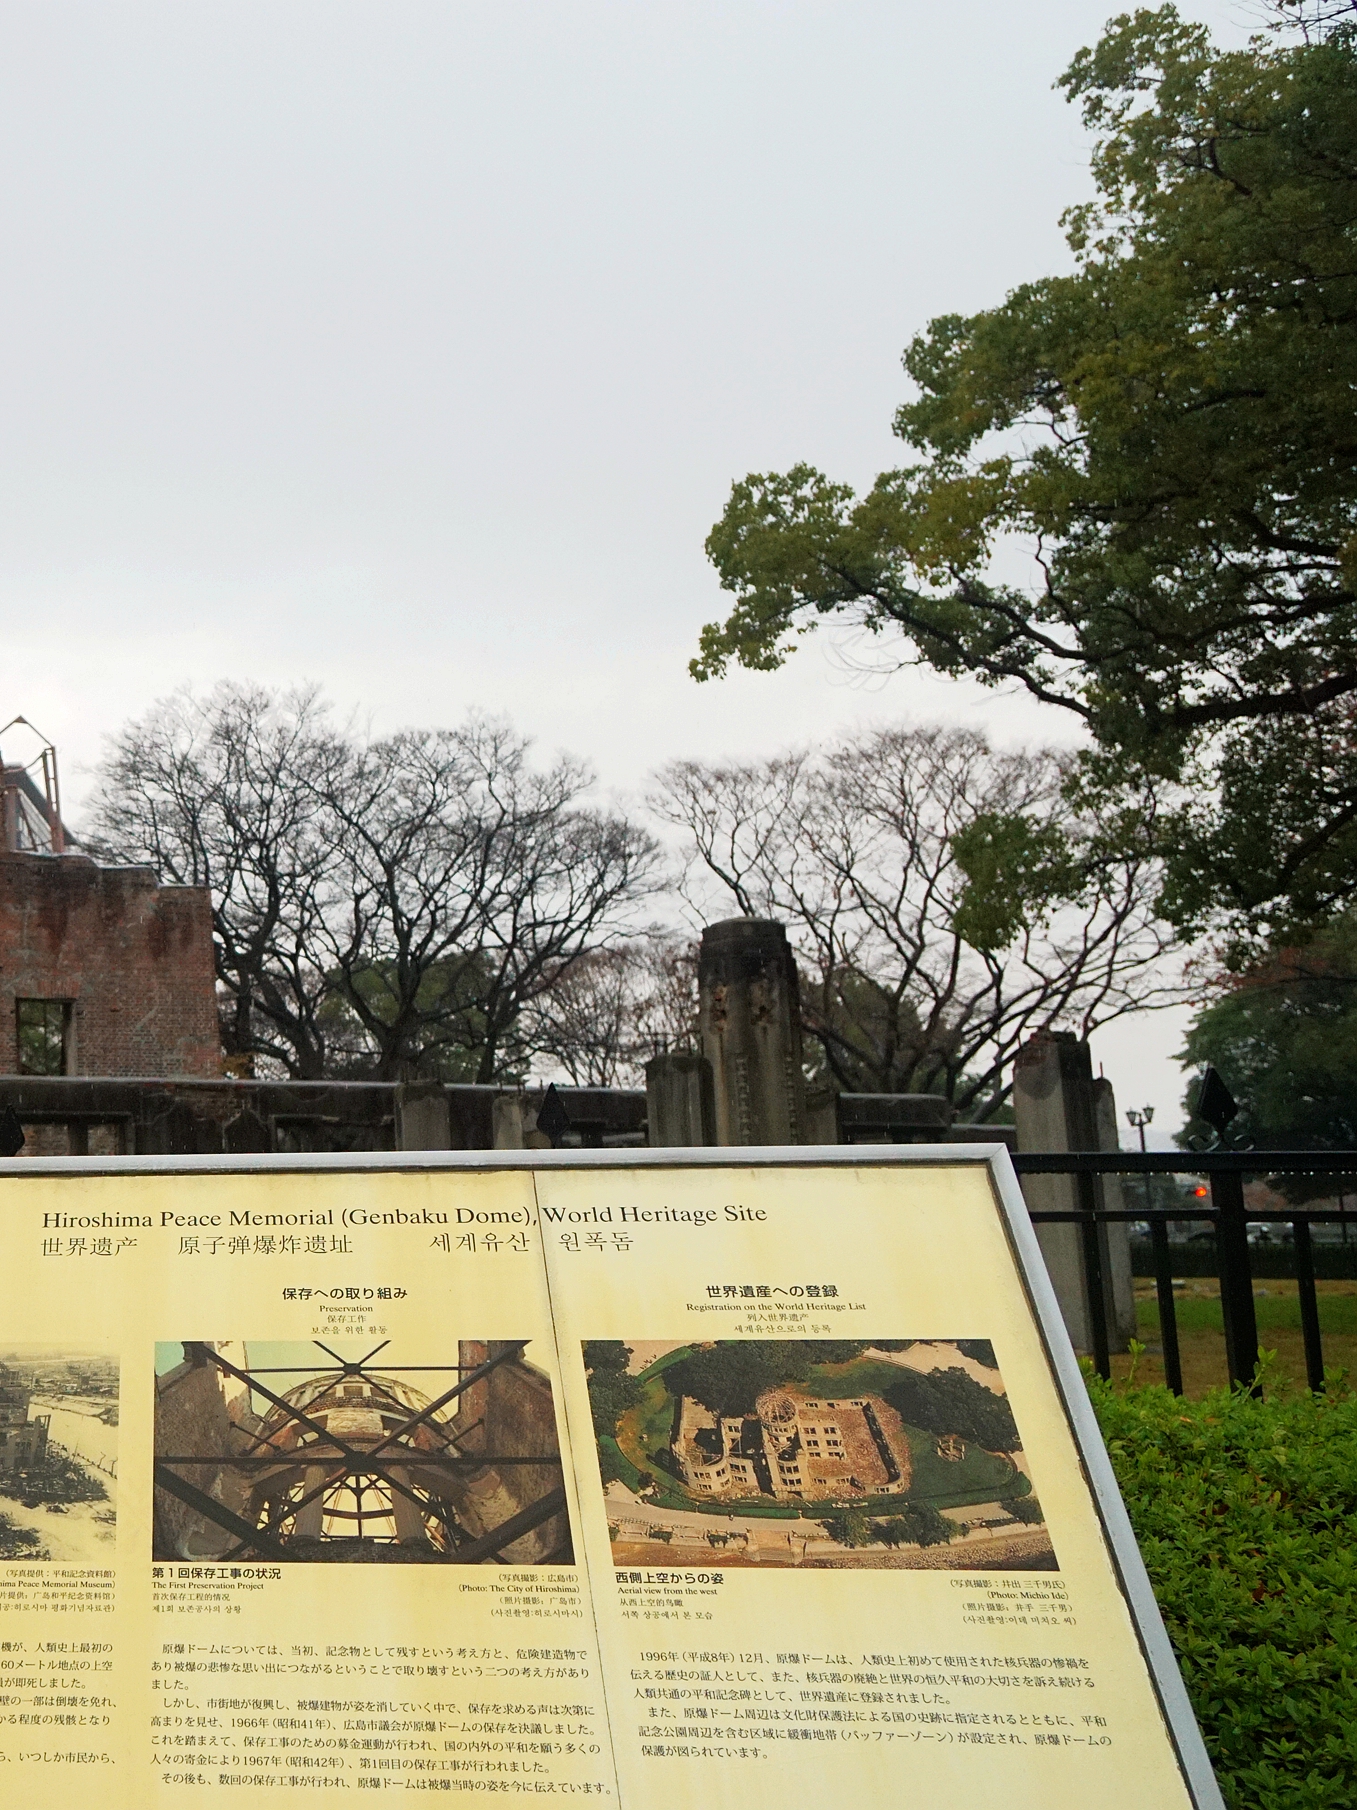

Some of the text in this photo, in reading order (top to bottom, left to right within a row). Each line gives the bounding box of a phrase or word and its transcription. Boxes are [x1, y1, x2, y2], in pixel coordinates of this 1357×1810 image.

[42, 1204, 768, 1229] Hiroshima Peace Memorial (Genbaku Dome), World Heritage Site
[41, 1233, 353, 1257] 世界遗产 原子弹爆炸遗址
[429, 1230, 634, 1253] 세계유산 원폭돔
[281, 1287, 408, 1301] 保存への取り組み
[705, 1284, 839, 1299] 世界遺産への登録
[319, 1304, 374, 1313] Preservation
[686, 1303, 741, 1312] Registration
[757, 1303, 773, 1311] the
[774, 1303, 804, 1311] World
[806, 1303, 847, 1313] Heritage
[848, 1303, 867, 1311] List
[18, 1579, 40, 1588] Peace
[41, 1579, 78, 1588] Memorial
[79, 1579, 117, 1589] Museum)
[615, 1571, 725, 1585] 西側上空からの姿
[151, 1581, 264, 1592] The First Preservation Project
[458, 1584, 580, 1595] (Photo: The City of Hiroshima)
[617, 1587, 718, 1596] Aerial view from the west
[1020, 1591, 1050, 1600] Michio
[150, 1678, 191, 1691] ました。
[640, 1744, 771, 1760] 保護が図られています。
